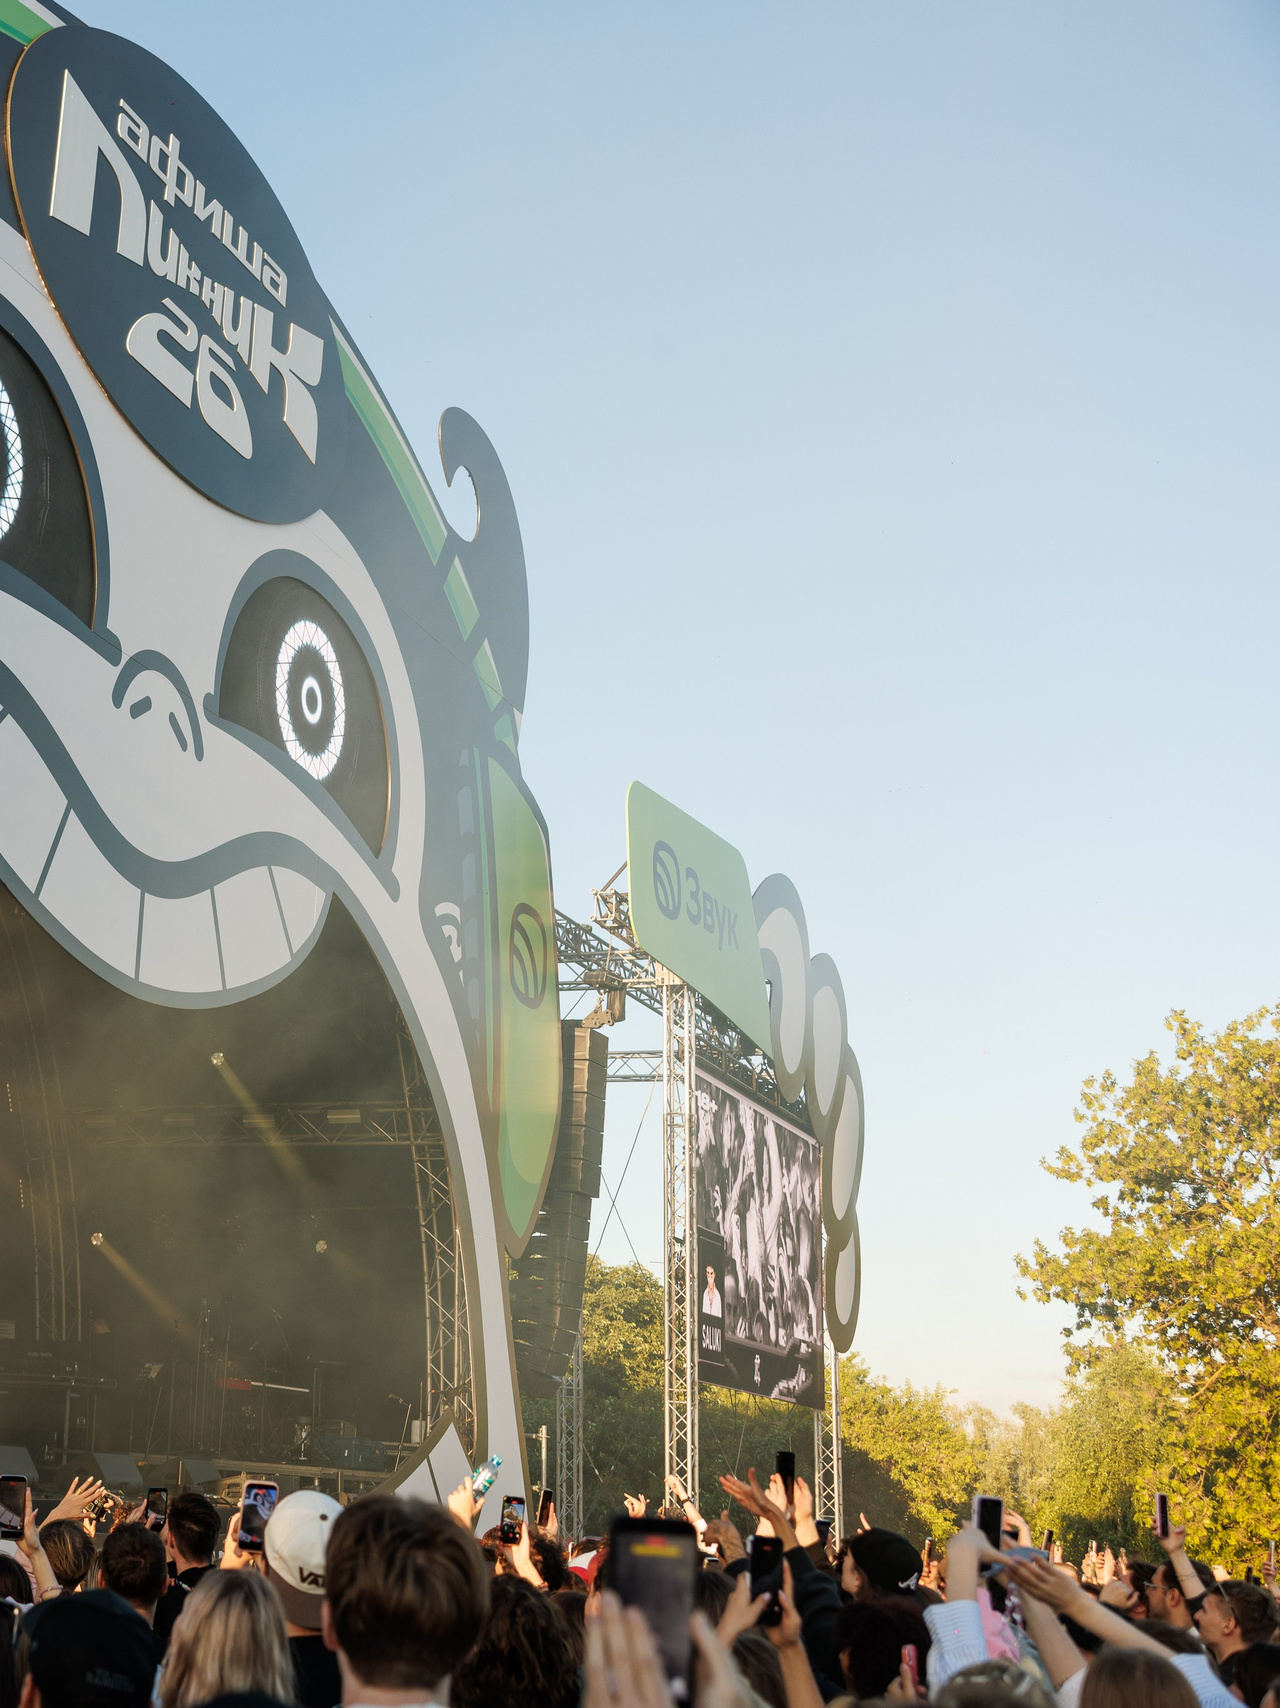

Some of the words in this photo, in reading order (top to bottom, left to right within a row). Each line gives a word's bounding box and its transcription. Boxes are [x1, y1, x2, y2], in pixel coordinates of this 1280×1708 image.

[126, 297, 253, 460] 26
[695, 1090, 718, 1113] 18+
[702, 1324, 722, 1352] SALUKI
